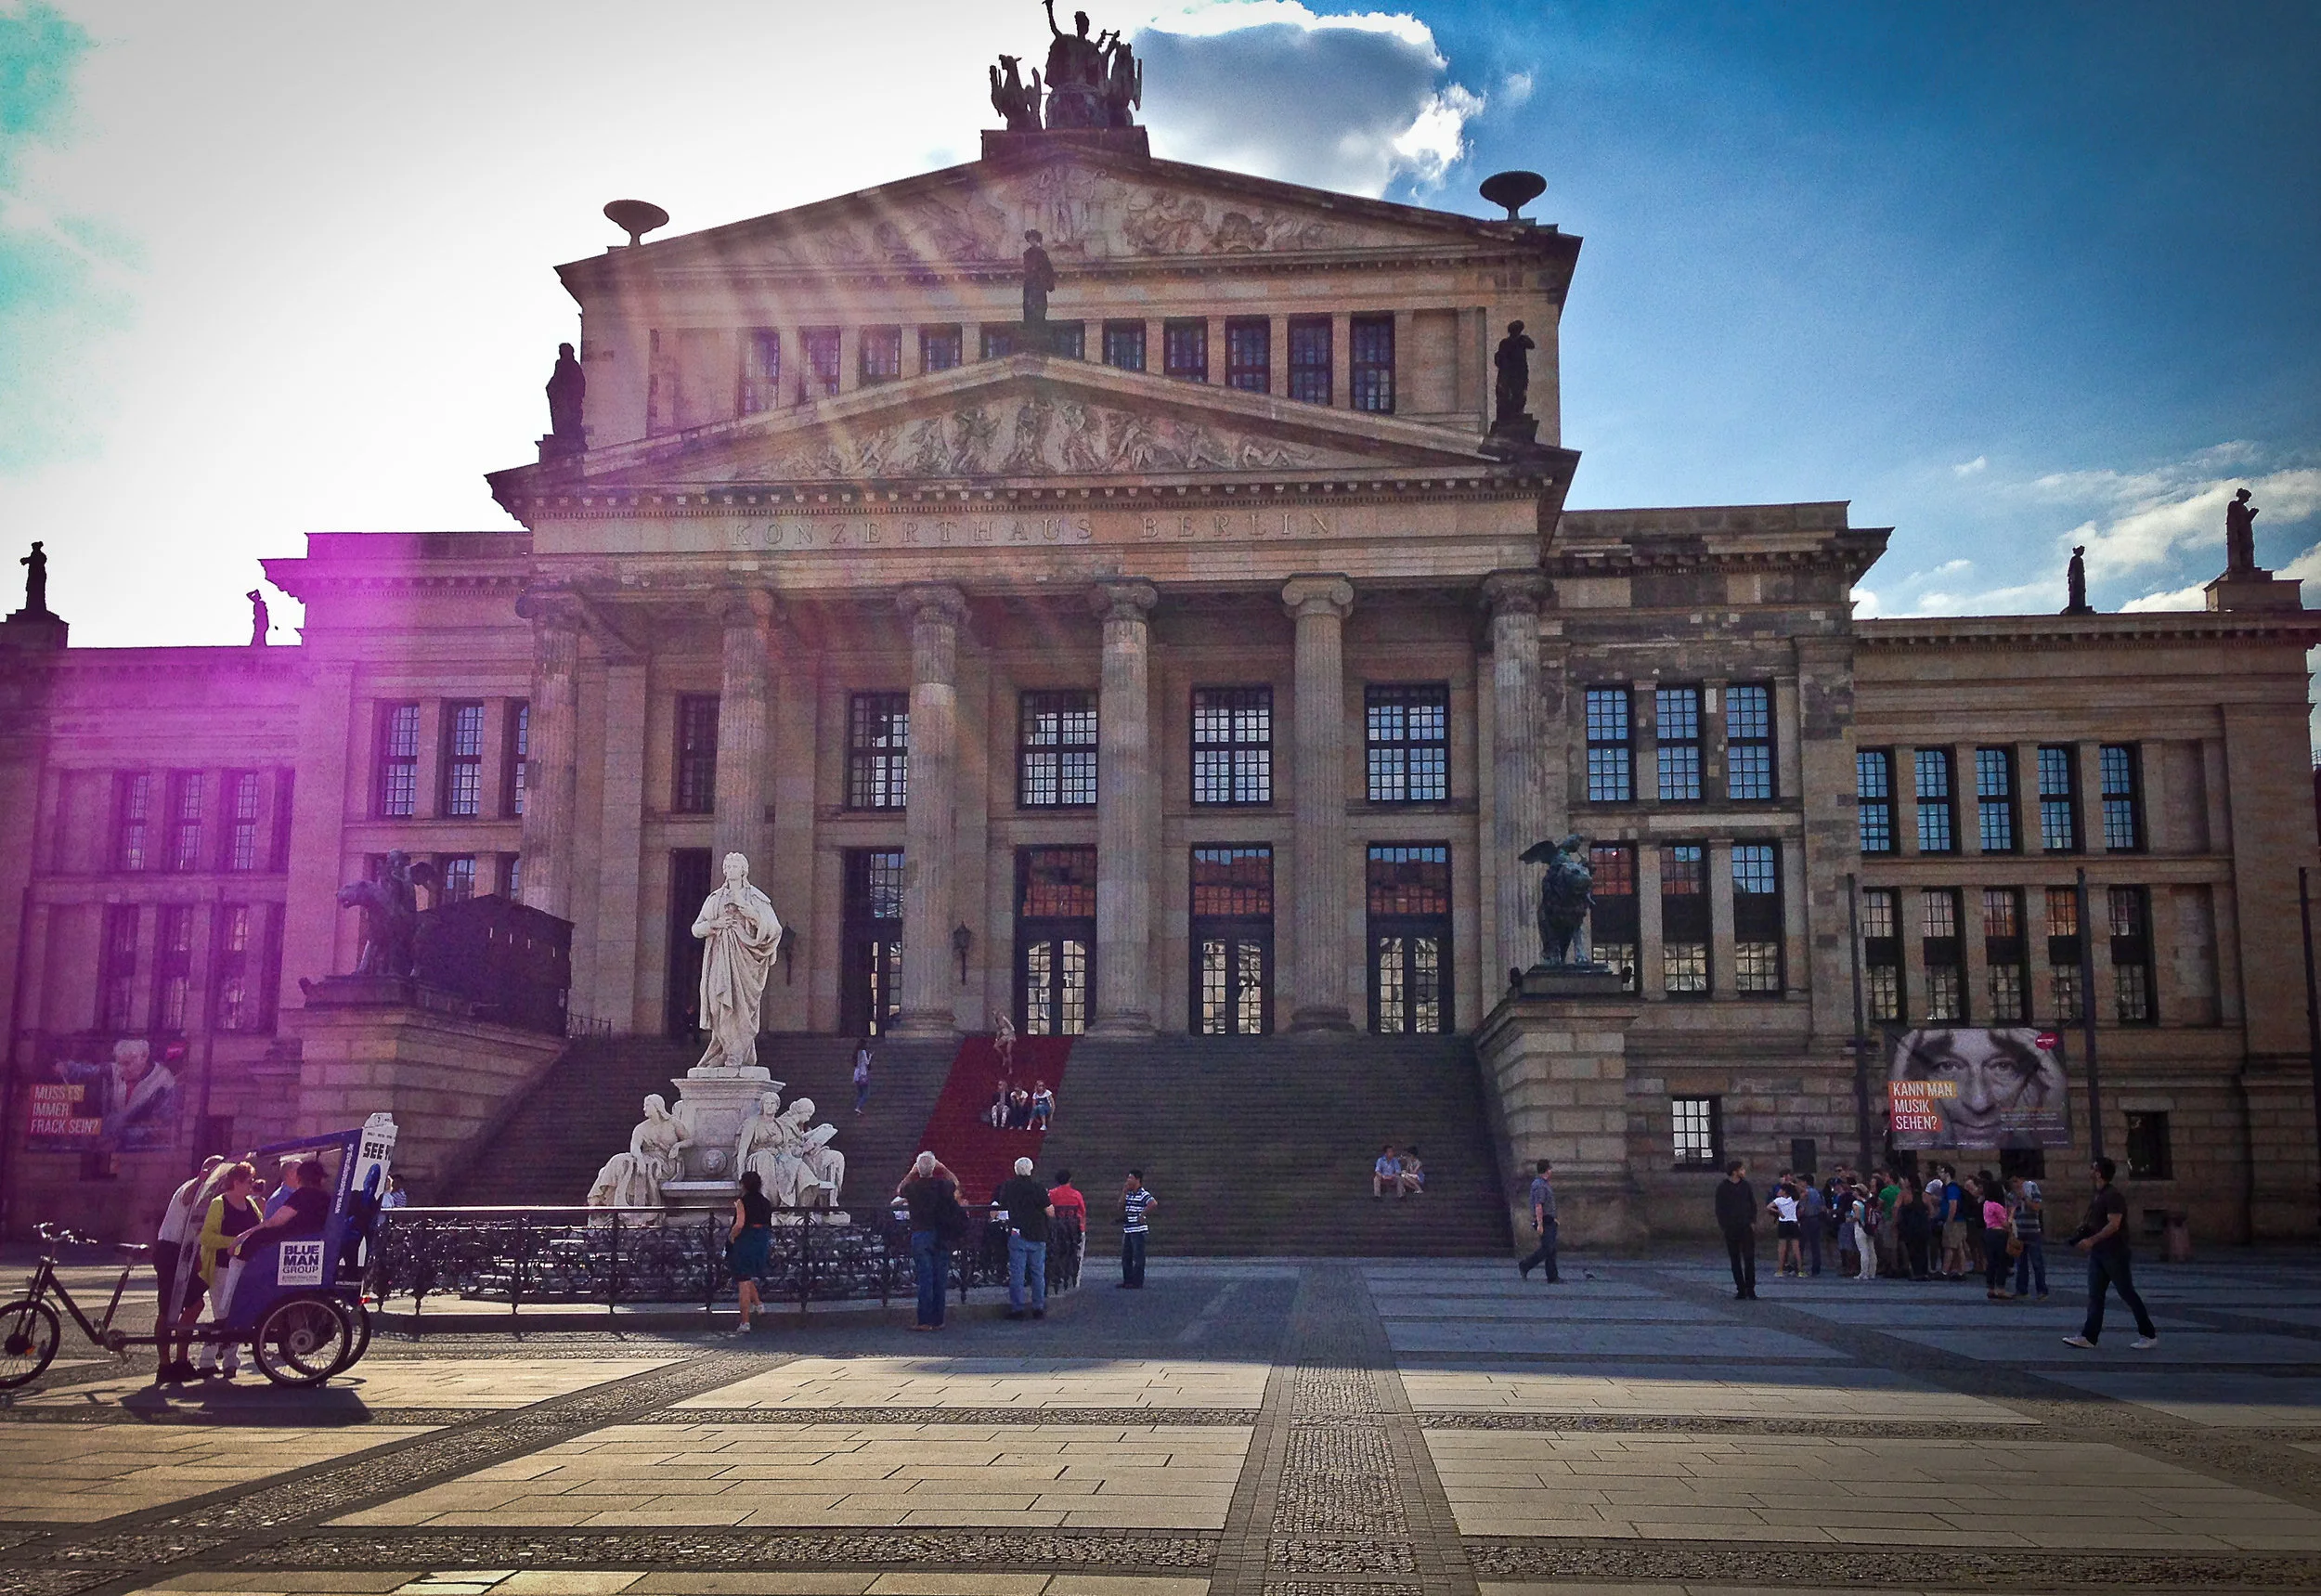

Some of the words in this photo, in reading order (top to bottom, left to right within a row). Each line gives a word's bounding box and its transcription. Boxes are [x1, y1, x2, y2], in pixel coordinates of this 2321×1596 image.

[732, 518, 1093, 546] KONZERTHAUS
[1141, 513, 1329, 539] BERLIN
[35, 1084, 66, 1100] MUSS
[68, 1084, 81, 1100] ES
[1893, 1083, 1924, 1096] KANN
[1927, 1083, 1953, 1096] MAN
[32, 1102, 70, 1117] IMMER
[1895, 1099, 1929, 1113] MUSIK
[31, 1119, 65, 1134] FRACK
[69, 1118, 98, 1134] SEIN?
[1896, 1115, 1938, 1130] SEHEN?
[363, 1141, 384, 1160] SEE
[284, 1245, 319, 1254] BLUE
[284, 1255, 318, 1265] MAN
